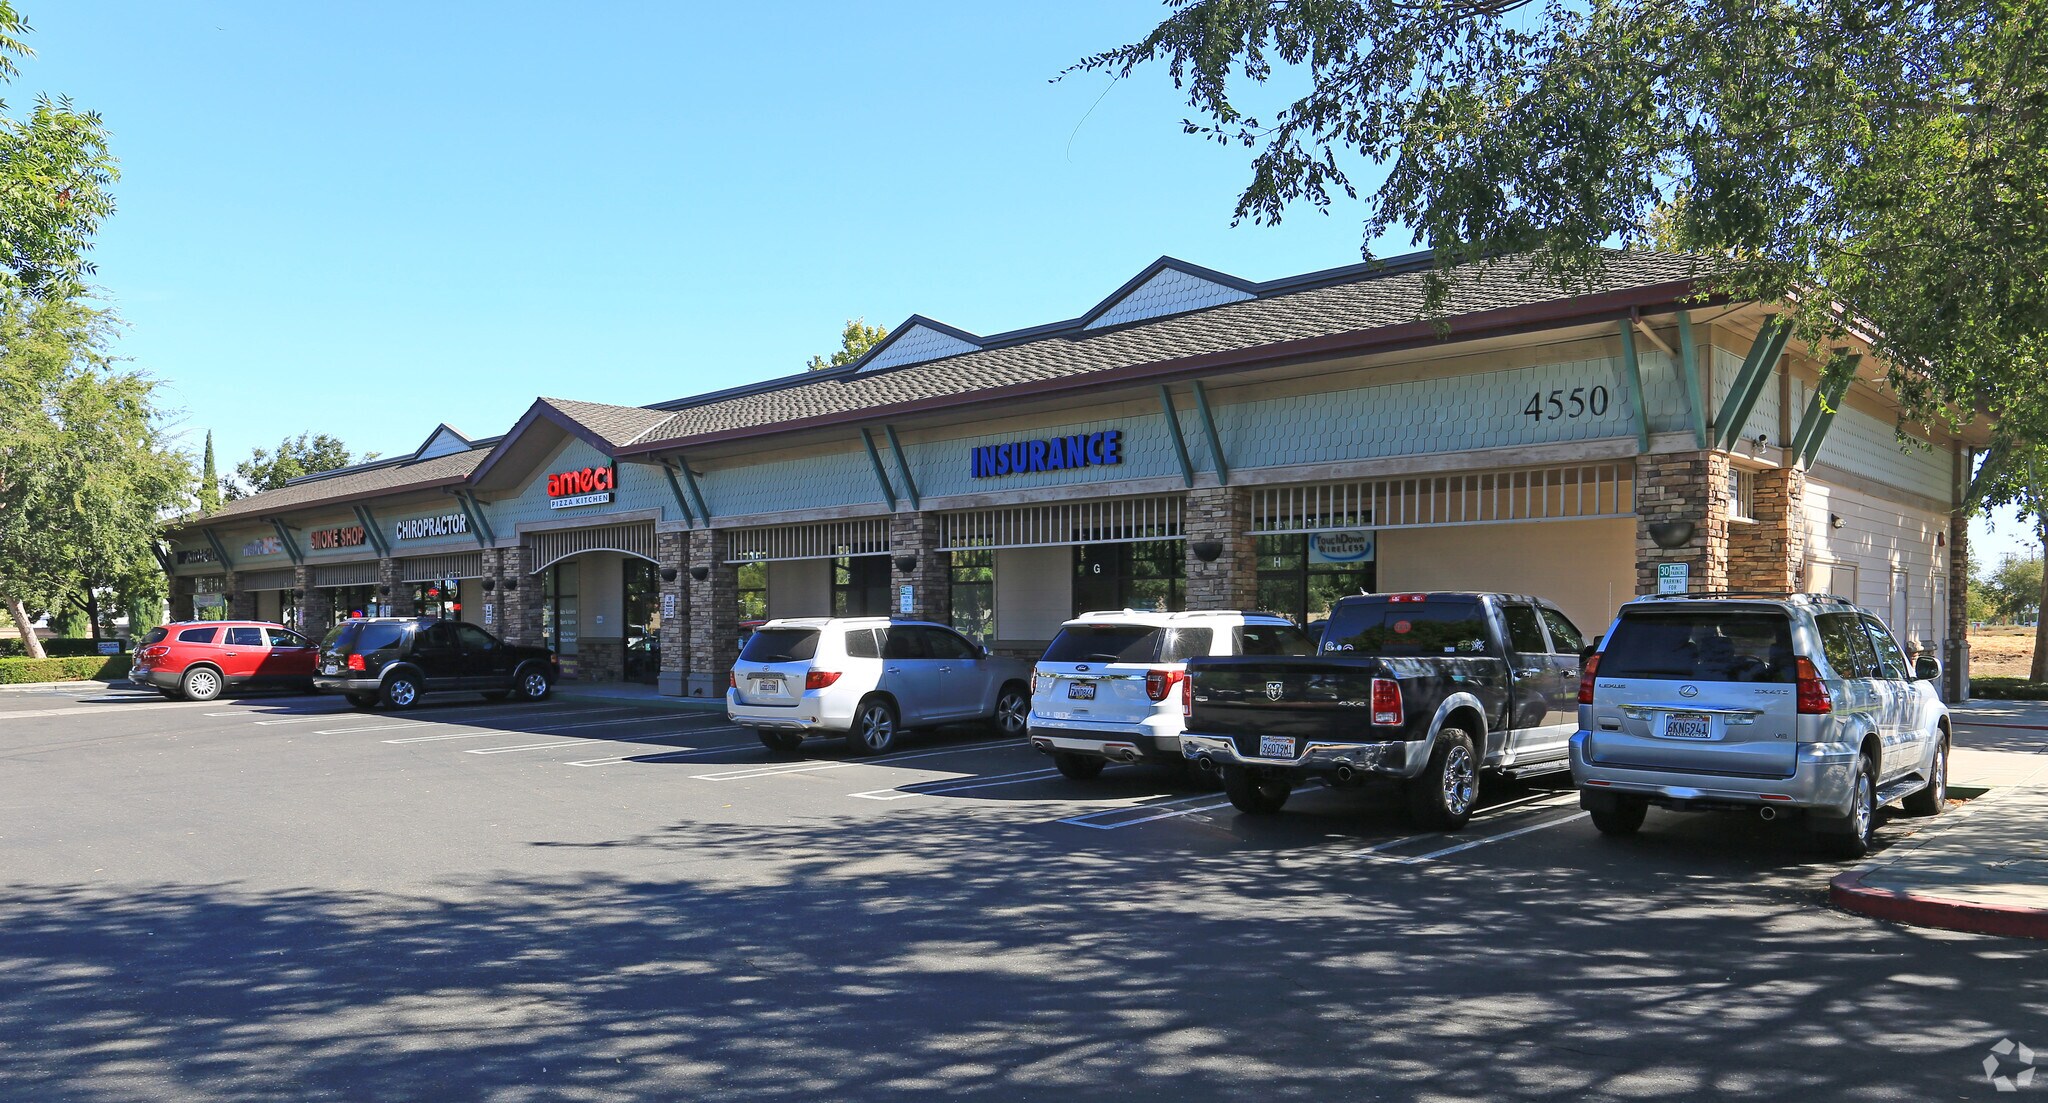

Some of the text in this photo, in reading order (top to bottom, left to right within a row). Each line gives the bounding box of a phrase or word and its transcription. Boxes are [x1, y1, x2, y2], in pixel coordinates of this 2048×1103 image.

[1524, 385, 1609, 421] 4550
[971, 430, 1120, 478] INSURANCE
[547, 463, 614, 497] ameci
[551, 494, 608, 508] PIZZA KITCHEN
[396, 513, 467, 539] CHIROPRACTOR
[310, 526, 364, 549] SMOKE SHOP
[1093, 563, 1101, 574] G
[1273, 556, 1281, 568] H
[1660, 566, 1670, 576] 30
[1667, 721, 1707, 734] 6KNG941
